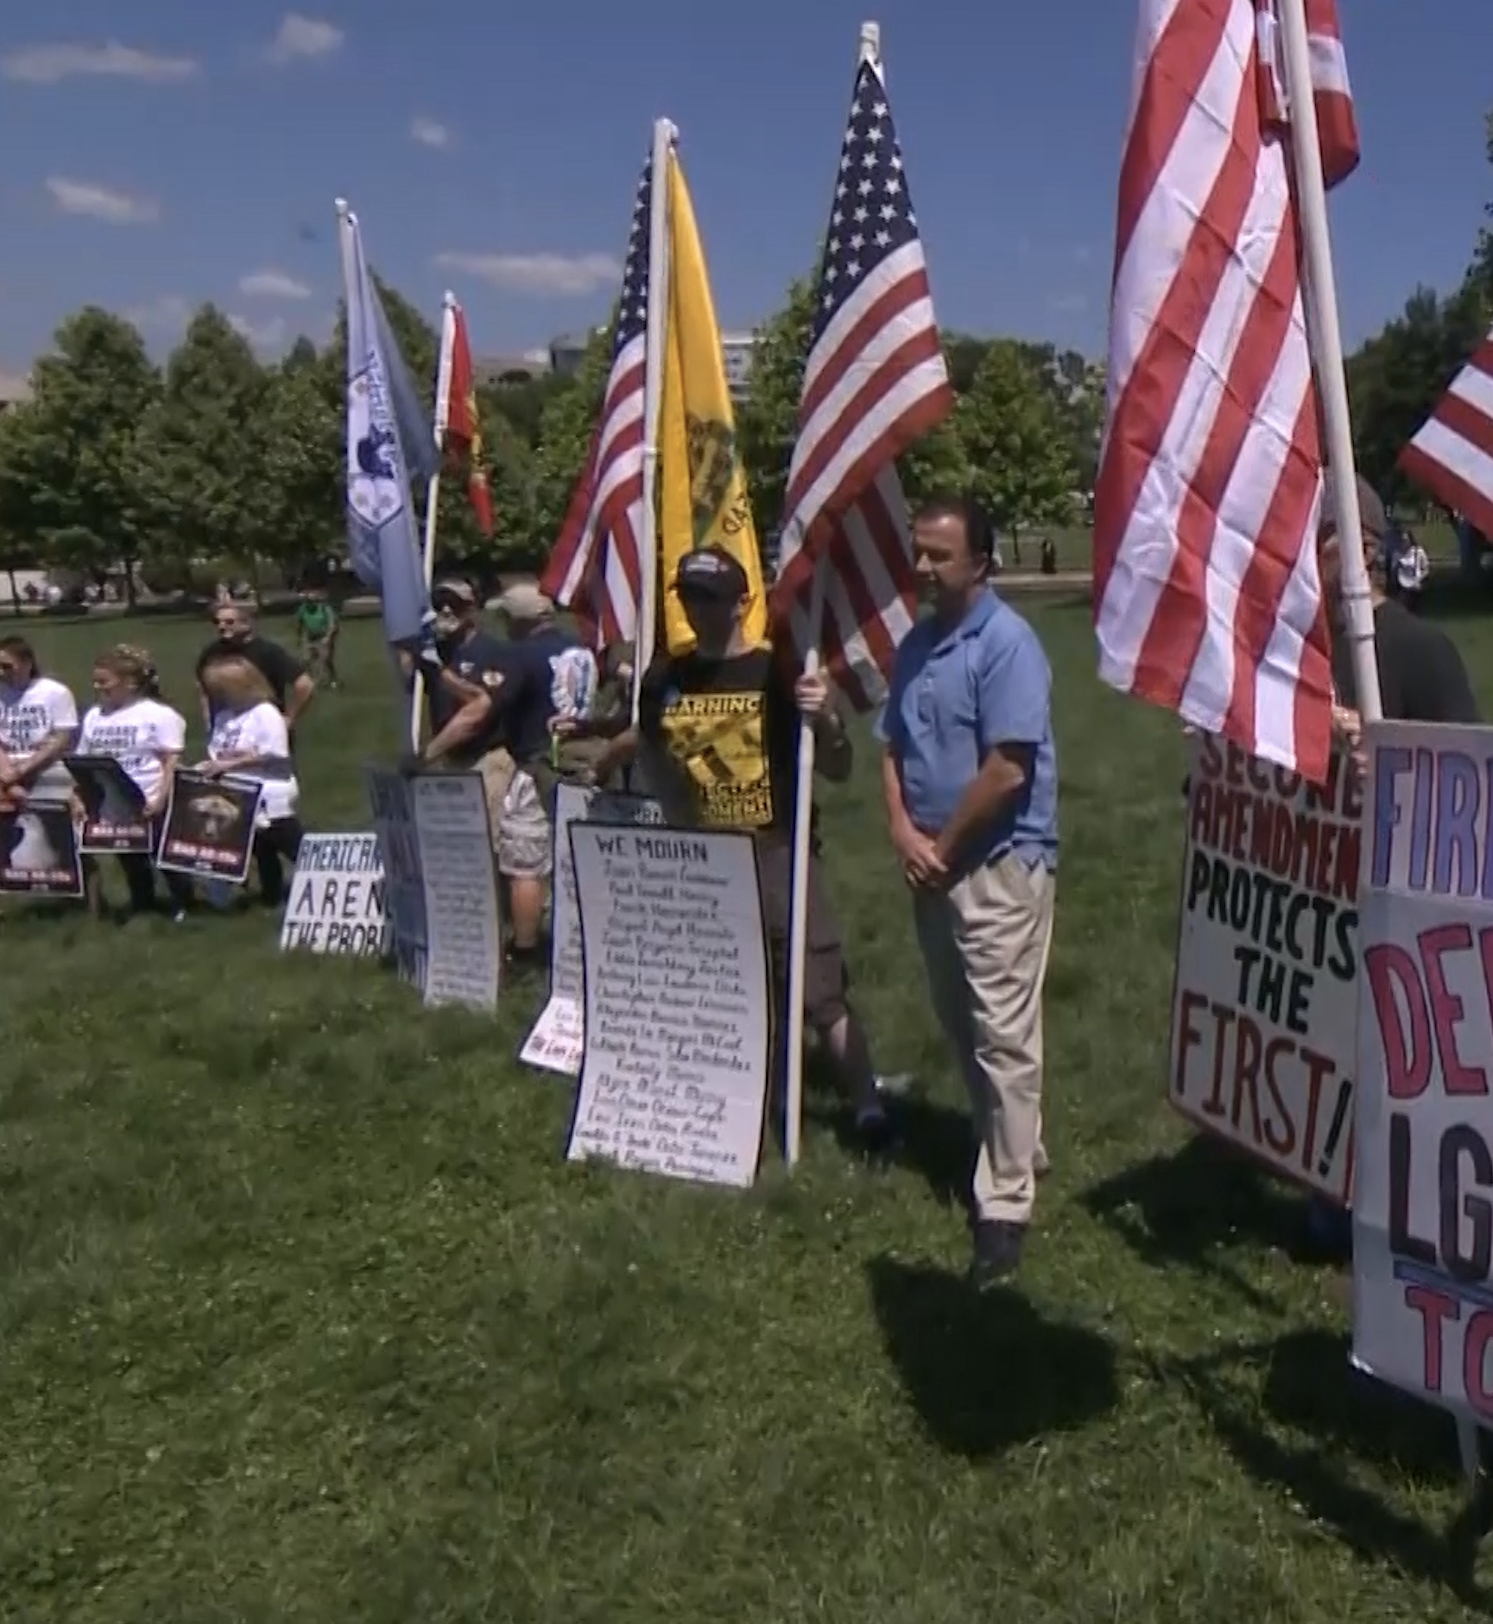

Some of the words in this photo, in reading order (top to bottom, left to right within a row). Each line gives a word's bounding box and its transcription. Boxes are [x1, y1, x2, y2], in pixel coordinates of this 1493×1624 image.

[595, 834, 627, 856] WE
[635, 836, 709, 863] MOURN
[1187, 850, 1359, 980] PROTECTS
[1234, 946, 1314, 1035] THE
[1176, 988, 1353, 1178] FIRST!
